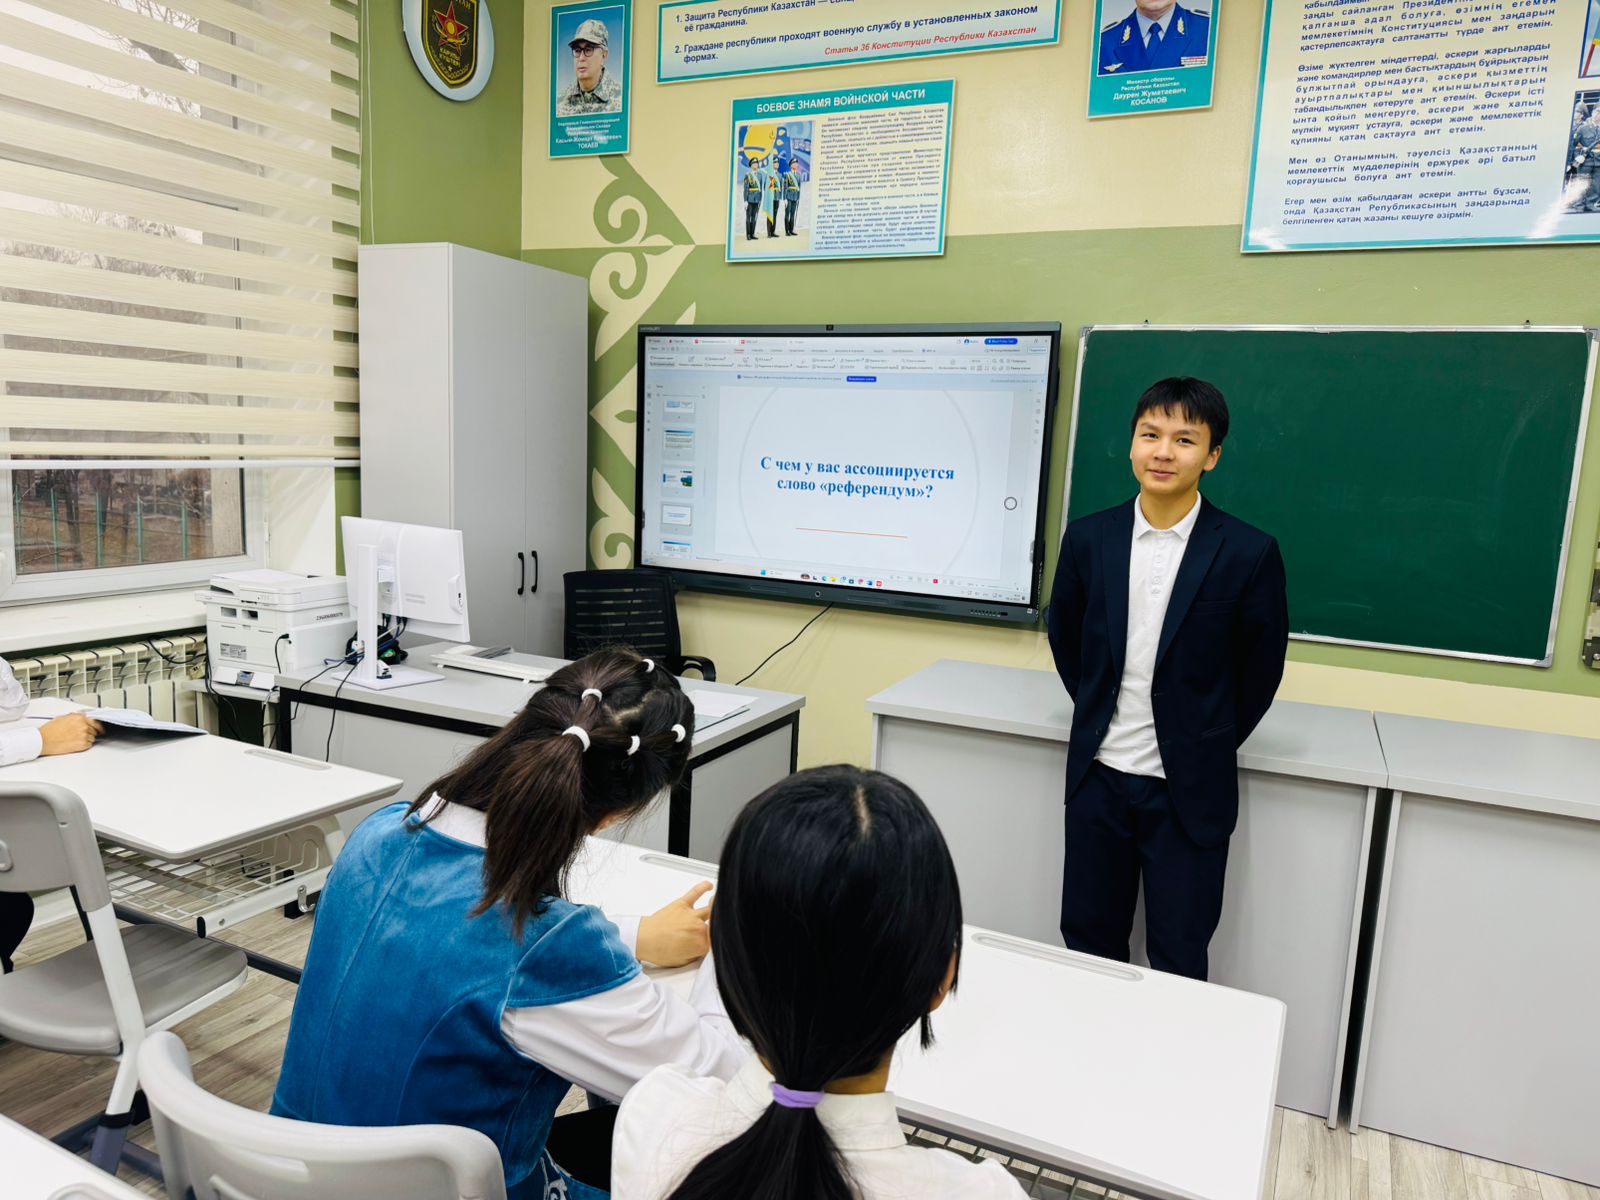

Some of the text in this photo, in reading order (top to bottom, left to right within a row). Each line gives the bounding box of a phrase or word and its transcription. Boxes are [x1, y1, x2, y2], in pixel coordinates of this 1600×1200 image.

[676, 0, 816, 23] 1. Защита Республики Казахстан
[1303, 11, 1334, 20] заңды
[1341, 4, 1395, 16] сайланған
[1364, 15, 1392, 24] адал
[1455, 2, 1503, 14] өзімнің
[674, 45, 682, 54] 2.
[683, 42, 724, 54] Граждане
[725, 36, 777, 49] республики
[778, 31, 821, 43] проходят
[823, 26, 865, 37] военную
[866, 20, 902, 33] службу
[912, 11, 992, 29] установленных
[994, 6, 1038, 18] законом
[684, 18, 748, 33] её гражданина.
[1300, 19, 1553, 52] қастерлепсақтауға салтанатты түрде ант етемін.
[1301, 28, 1374, 41] мемлекетімнің
[1381, 19, 1463, 32] Конституциясы
[1500, 9, 1555, 20] заңдарын
[825, 46, 858, 55] Статья
[872, 39, 932, 50] Конституции
[932, 33, 986, 44] Республики
[986, 27, 1037, 38] Казахстан
[683, 53, 719, 64] формах.
[1298, 64, 1324, 72] Өзіме
[1328, 60, 1376, 70] жүктелген
[1444, 50, 1479, 59] әскери
[1483, 43, 1551, 55] жарғыларды
[1321, 70, 1382, 80] командирлер
[1404, 61, 1476, 73] бастықтардың
[1478, 55, 1549, 67] бұйрықтарын
[1295, 81, 1356, 94] бұлжытпай
[1437, 72, 1478, 81] әскери
[1486, 65, 1548, 77] қызметтің
[1431, 77, 1546, 92] қиыншылықтарын
[756, 101, 795, 113] БОЕВОЕ
[798, 98, 831, 110] ЗНАМЯ
[891, 88, 926, 100] ЧАСТИ
[1131, 96, 1167, 106] КОСАНОВ
[1294, 103, 1367, 114] табандылықпен
[1373, 98, 1414, 108] көтеруге
[1442, 93, 1478, 102] етемін.
[1484, 90, 1521, 99] Әскери
[1527, 86, 1545, 96] істі
[1291, 126, 1322, 135] мүлкін
[1327, 123, 1360, 133] мұқият
[1409, 118, 1443, 126] әскери
[1480, 110, 1542, 121] мемлекеттік
[1292, 116, 1317, 124] ынта
[1324, 113, 1357, 122] қойып
[1427, 105, 1465, 114] әскери
[1472, 102, 1500, 111] және
[1508, 99, 1544, 108] халық
[1290, 136, 1332, 146] құпияны
[1339, 134, 1366, 142] қатаң
[1373, 130, 1416, 139] сақтауға
[1448, 125, 1486, 134] етемін.
[1287, 154, 1536, 175] мемлекеттік мүдделерінің ержүрек әрі батыл
[1288, 157, 1308, 165] Мен
[1406, 148, 1451, 159] тәуелсіз
[1459, 144, 1538, 155] Қазақстанның
[1286, 176, 1347, 186] қорғаушысы
[1354, 173, 1388, 182] болуға
[1419, 169, 1456, 178] етемін.
[1284, 198, 1305, 206] Егер
[1357, 193, 1413, 202] қабылдаған
[1418, 191, 1452, 200] әскери
[1313, 206, 1361, 215] Қазақстан
[1464, 198, 1530, 208] заңдарында
[1363, 214, 1399, 222] жазаны
[1401, 213, 1434, 222] кешуге
[1436, 210, 1473, 220] әзірмін.
[760, 456, 955, 481] С чем у вас ассоциируется
[777, 480, 934, 499] слово «референдум»?
